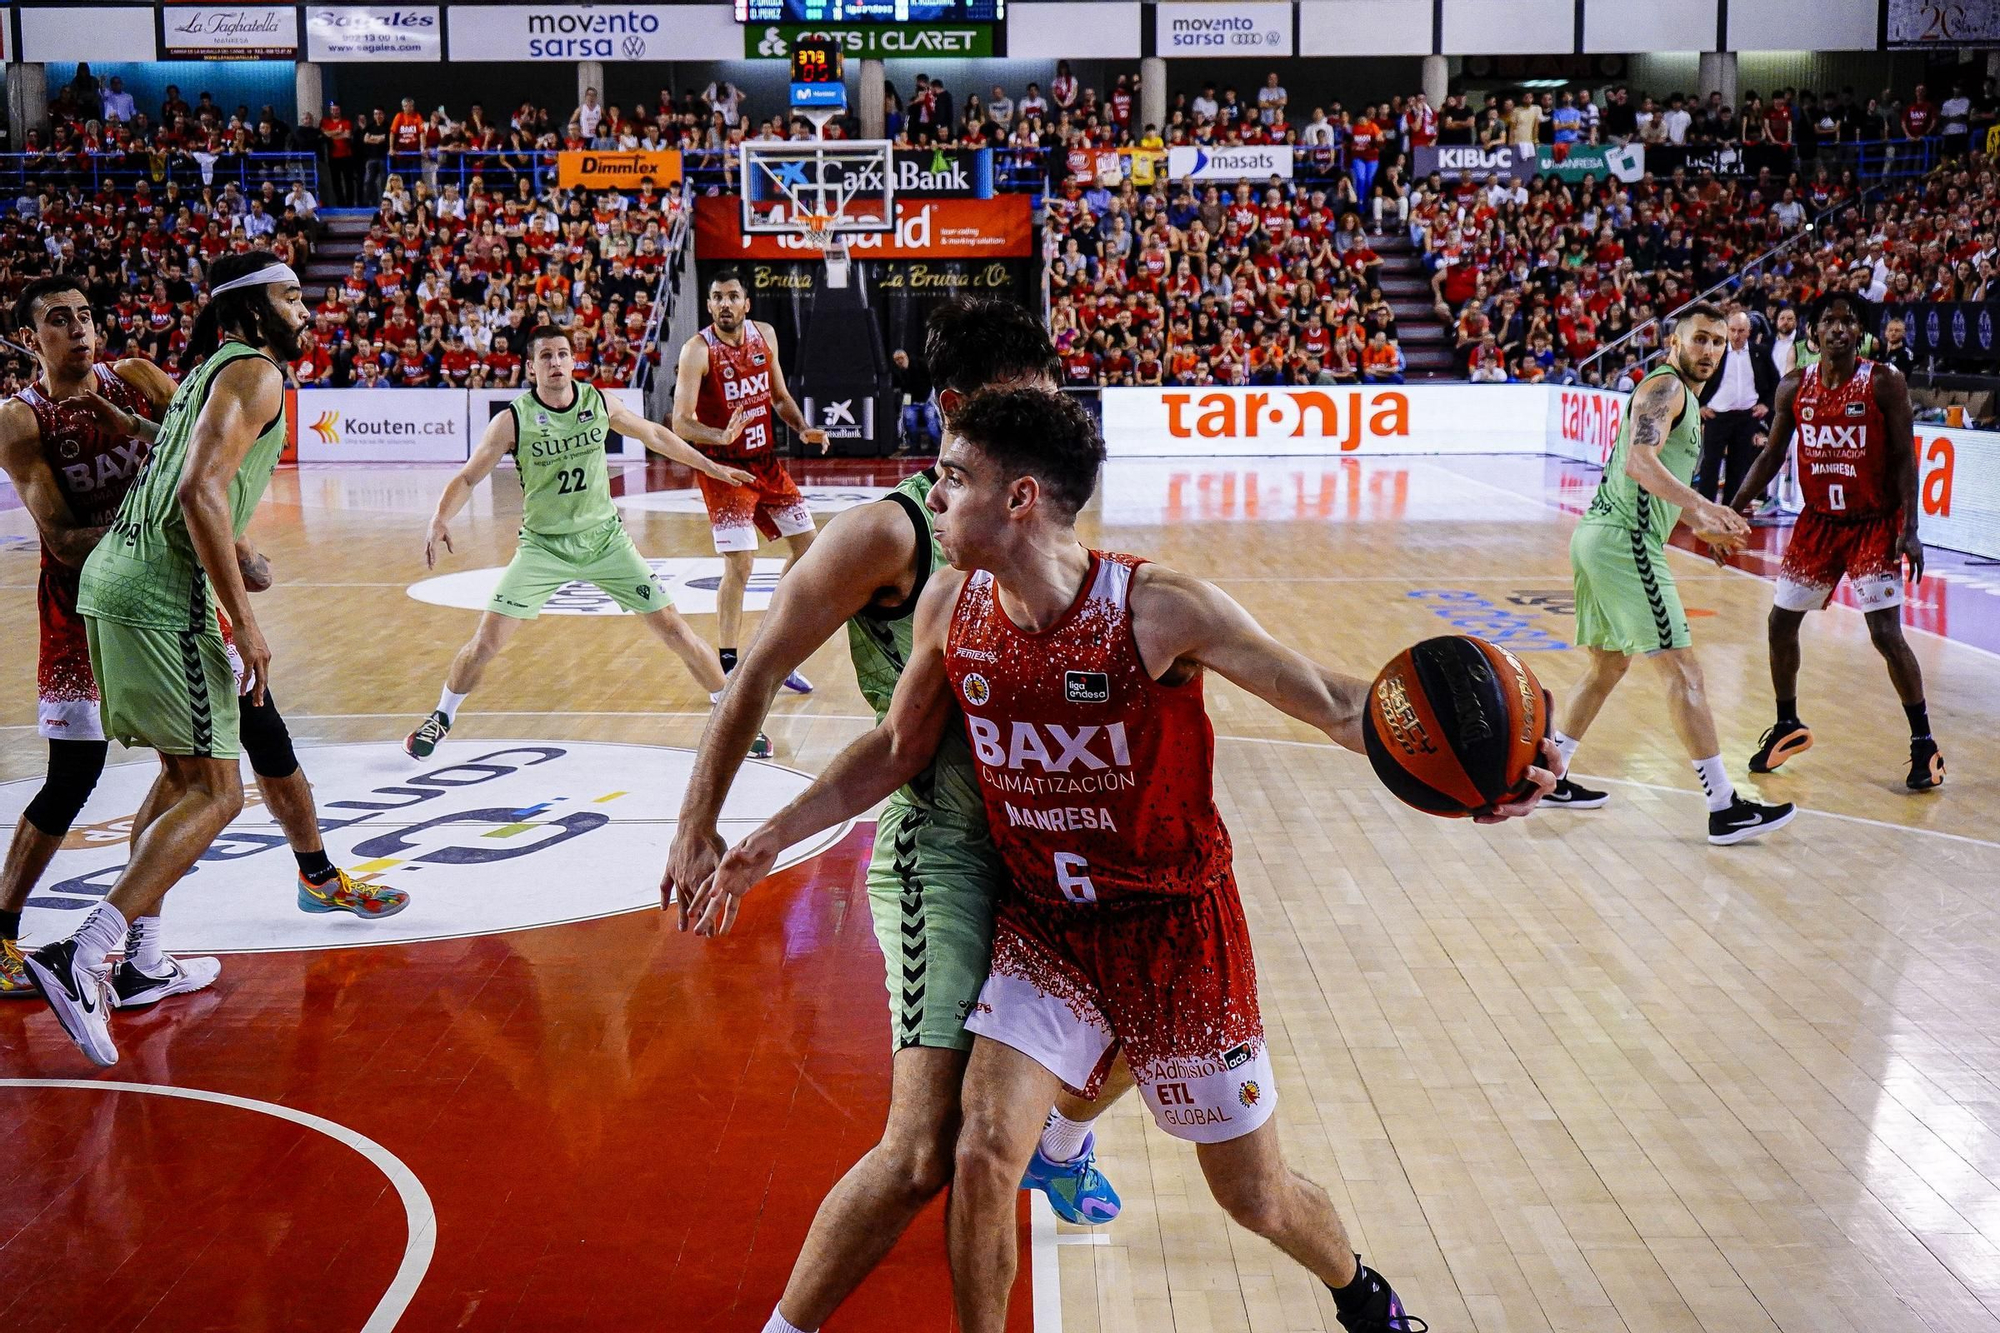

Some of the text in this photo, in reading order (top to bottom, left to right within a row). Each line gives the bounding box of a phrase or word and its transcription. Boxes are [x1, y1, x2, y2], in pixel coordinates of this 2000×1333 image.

[175, 12, 279, 36] La Tagliatella
[529, 10, 660, 33] movento
[1173, 17, 1253, 31] movento
[529, 38, 614, 57] sarsa
[880, 31, 977, 50] CLARET
[1174, 33, 1225, 45] sarsa
[581, 154, 658, 174] Dimmtex
[1211, 153, 1274, 170] masats
[1438, 148, 1512, 169] KIBUC
[822, 159, 971, 191] CaixaBank
[724, 371, 770, 401] BAXI
[345, 418, 456, 435] Kouten.cat
[1161, 391, 1409, 452] taronja
[532, 427, 602, 458] surne
[745, 423, 767, 450] 29
[1801, 423, 1867, 449] BAXI
[62, 438, 153, 493] BAX
[1811, 462, 1858, 478] MANRESA
[557, 467, 588, 495] 22
[1828, 483, 1847, 511] 0
[1069, 680, 1086, 691] liga
[1069, 688, 1106, 700] endesa
[967, 712, 1132, 773] BAXI
[982, 765, 1136, 796] CLIMATIZACIÓN
[1004, 801, 1118, 833] MANRESA
[1054, 852, 1098, 903] 6
[1228, 1051, 1248, 1069] acb
[1156, 1082, 1195, 1106] ETL
[1164, 1105, 1233, 1125] GLOBAL
